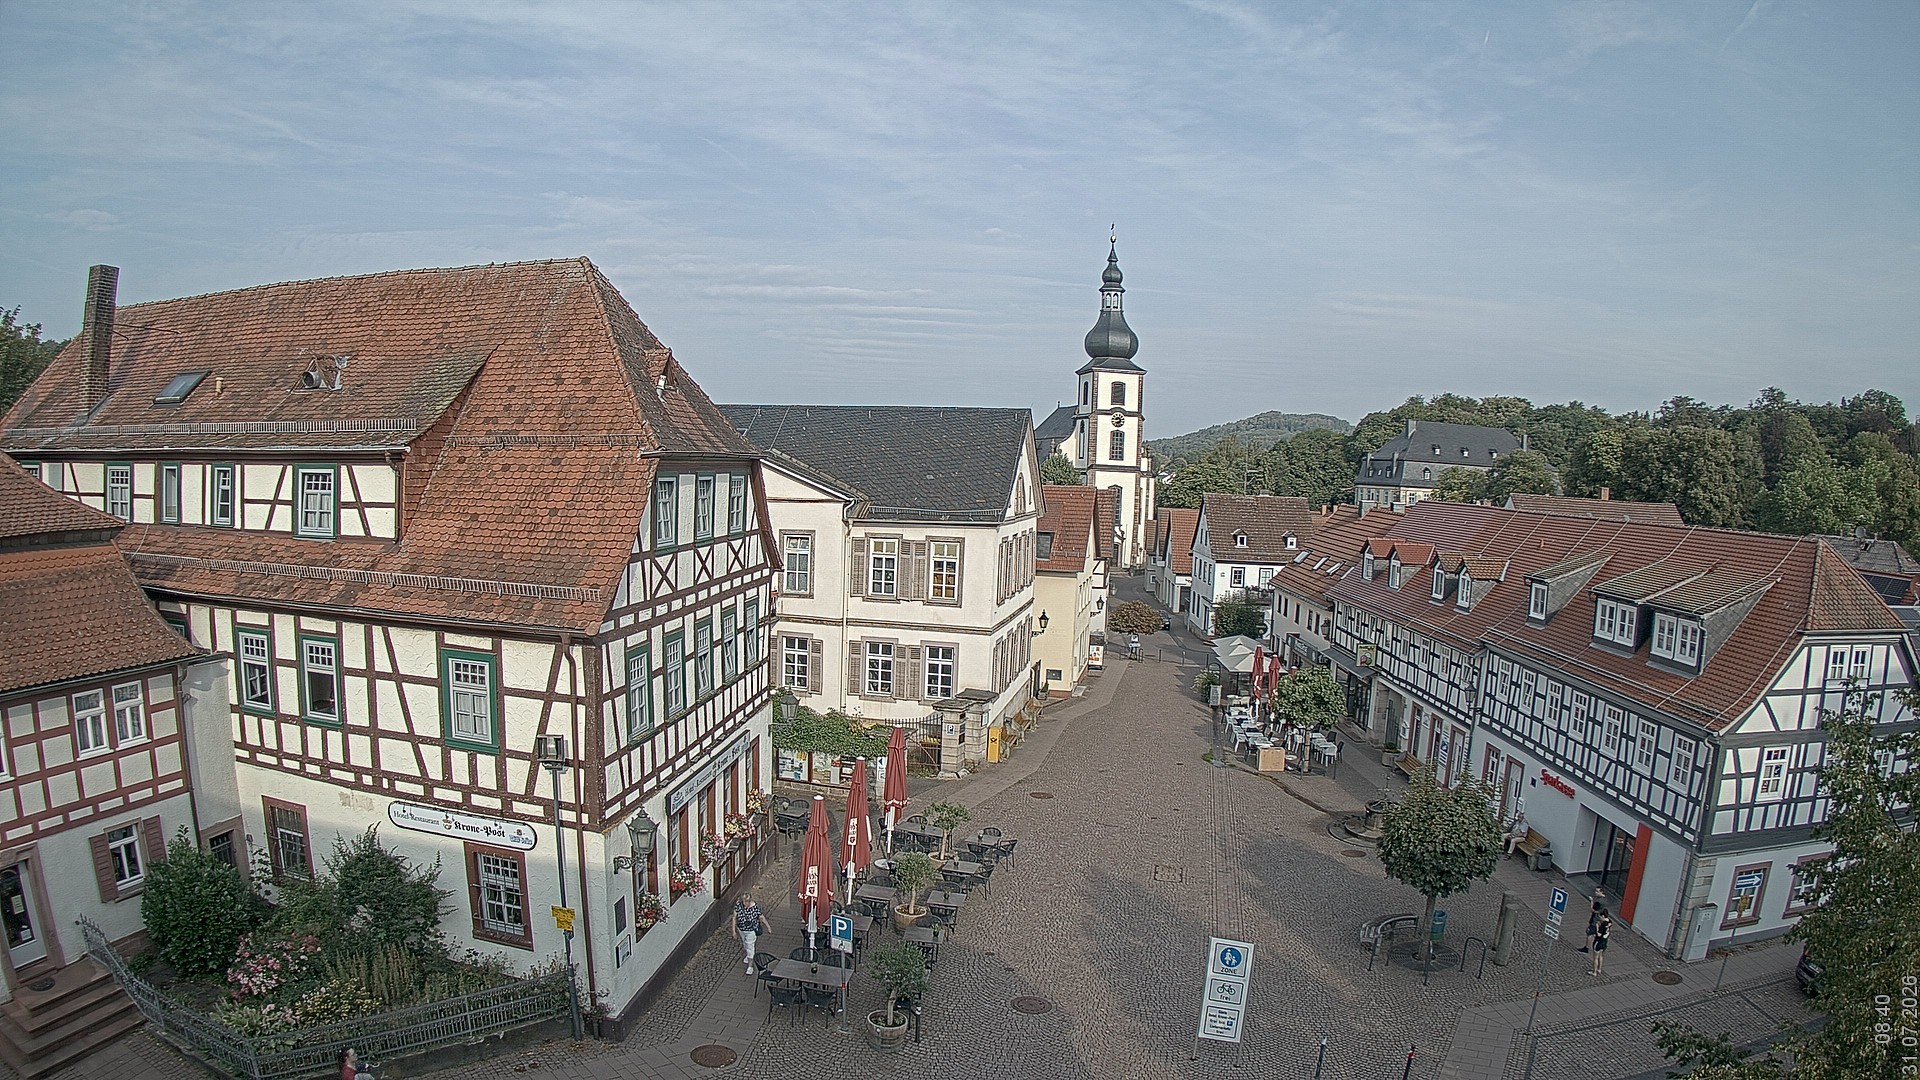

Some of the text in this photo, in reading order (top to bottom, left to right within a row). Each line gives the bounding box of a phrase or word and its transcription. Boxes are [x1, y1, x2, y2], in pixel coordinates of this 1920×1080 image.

[1540, 769, 1576, 799] Sparkasse
[454, 820, 506, 838] Krone-Post
[1553, 891, 1564, 907] P
[835, 919, 847, 935] P
